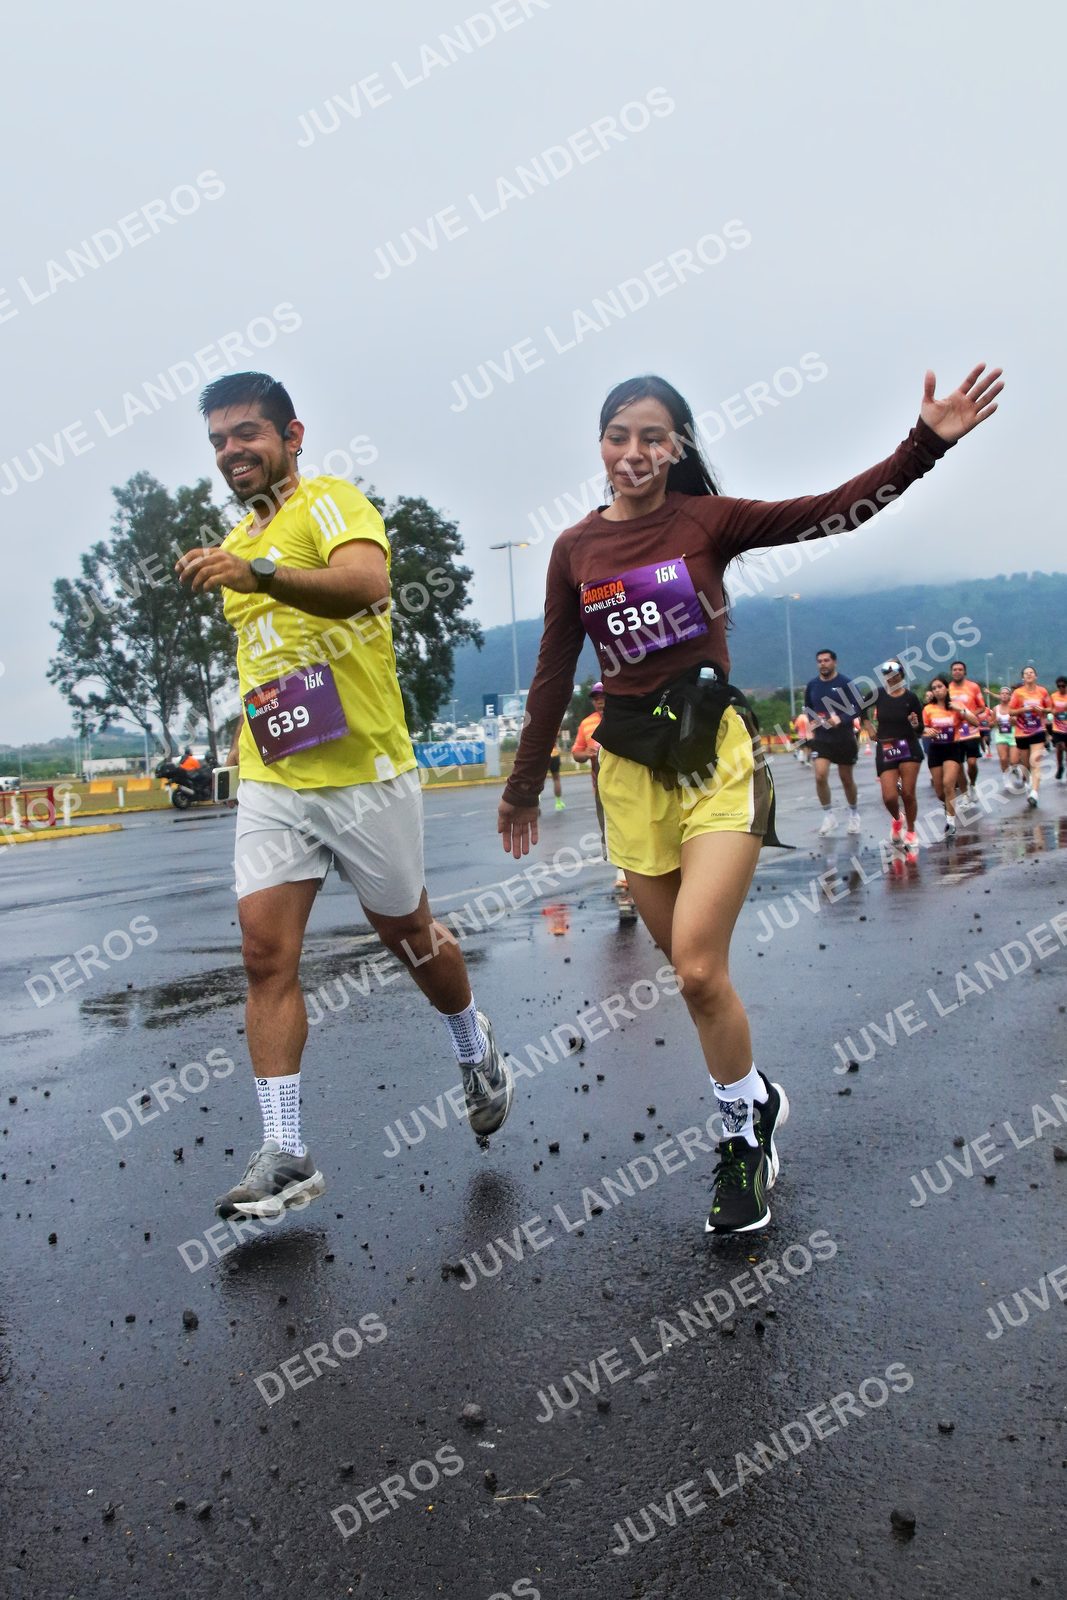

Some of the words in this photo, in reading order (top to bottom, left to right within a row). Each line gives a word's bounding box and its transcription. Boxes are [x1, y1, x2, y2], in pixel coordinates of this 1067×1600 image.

[655, 564, 678, 584] 15K
[583, 580, 625, 604] CARRERA
[607, 601, 661, 636] 638
[257, 610, 284, 653] K
[304, 671, 324, 691] 15K
[267, 705, 310, 738] 639
[485, 704, 495, 716] E
